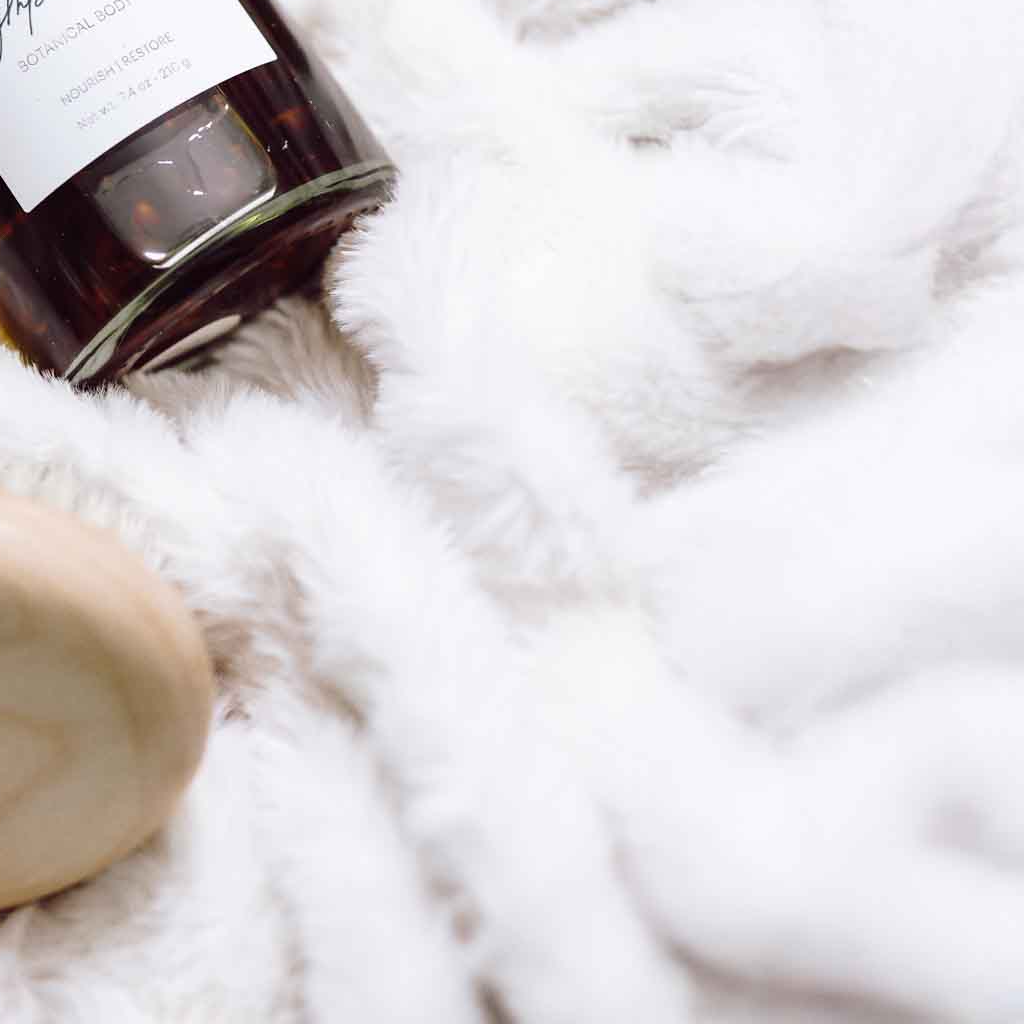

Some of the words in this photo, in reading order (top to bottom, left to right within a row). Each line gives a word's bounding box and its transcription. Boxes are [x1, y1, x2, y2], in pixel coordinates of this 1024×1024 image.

[17, 17, 95, 73] BOTANICAL
[59, 66, 116, 106] NOURISH
[121, 31, 175, 67] RESTORE
